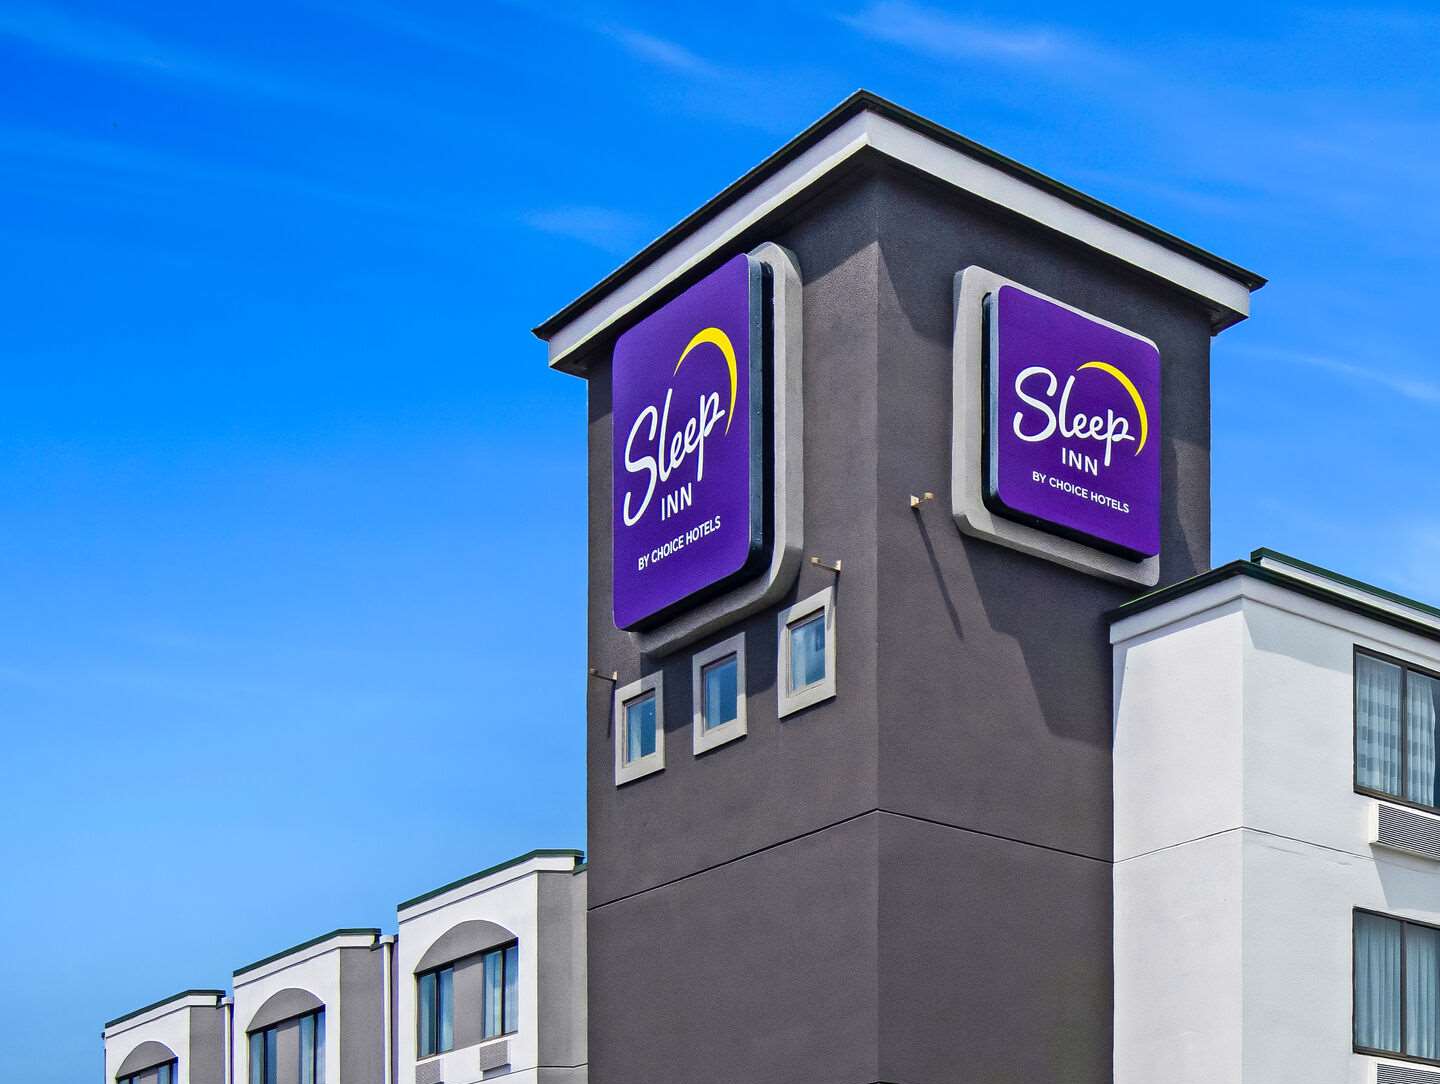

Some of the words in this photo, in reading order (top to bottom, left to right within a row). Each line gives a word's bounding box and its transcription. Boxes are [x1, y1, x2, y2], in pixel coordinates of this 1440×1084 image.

[1013, 366, 1135, 467] Sleep
[623, 387, 726, 527] Sleep
[1061, 447, 1098, 477] INN
[661, 482, 693, 521] INN
[1032, 470, 1047, 484] BY
[1048, 476, 1089, 499] CHOICE
[1090, 491, 1130, 514] HOTELS
[637, 553, 650, 571] BY
[650, 534, 685, 563] CHOICE
[685, 515, 721, 546] HOTELS
